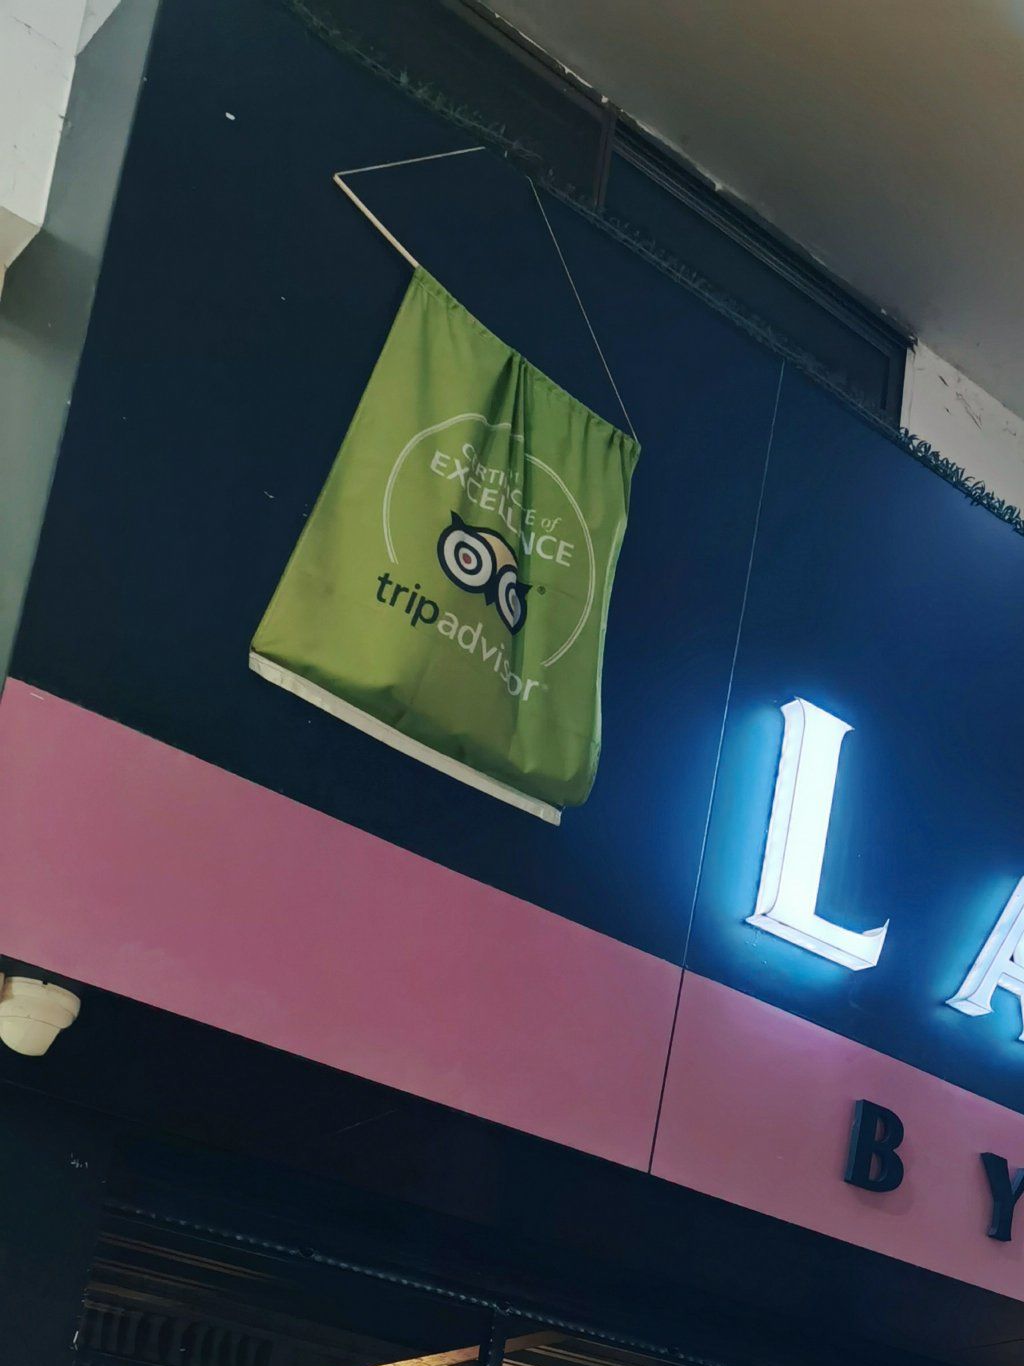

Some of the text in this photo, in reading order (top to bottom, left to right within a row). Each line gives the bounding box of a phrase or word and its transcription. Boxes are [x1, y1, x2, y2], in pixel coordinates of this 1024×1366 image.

[430, 450, 575, 567] EXCELLNCE
[541, 514, 562, 533] of
[375, 572, 540, 701] tripadvisor
